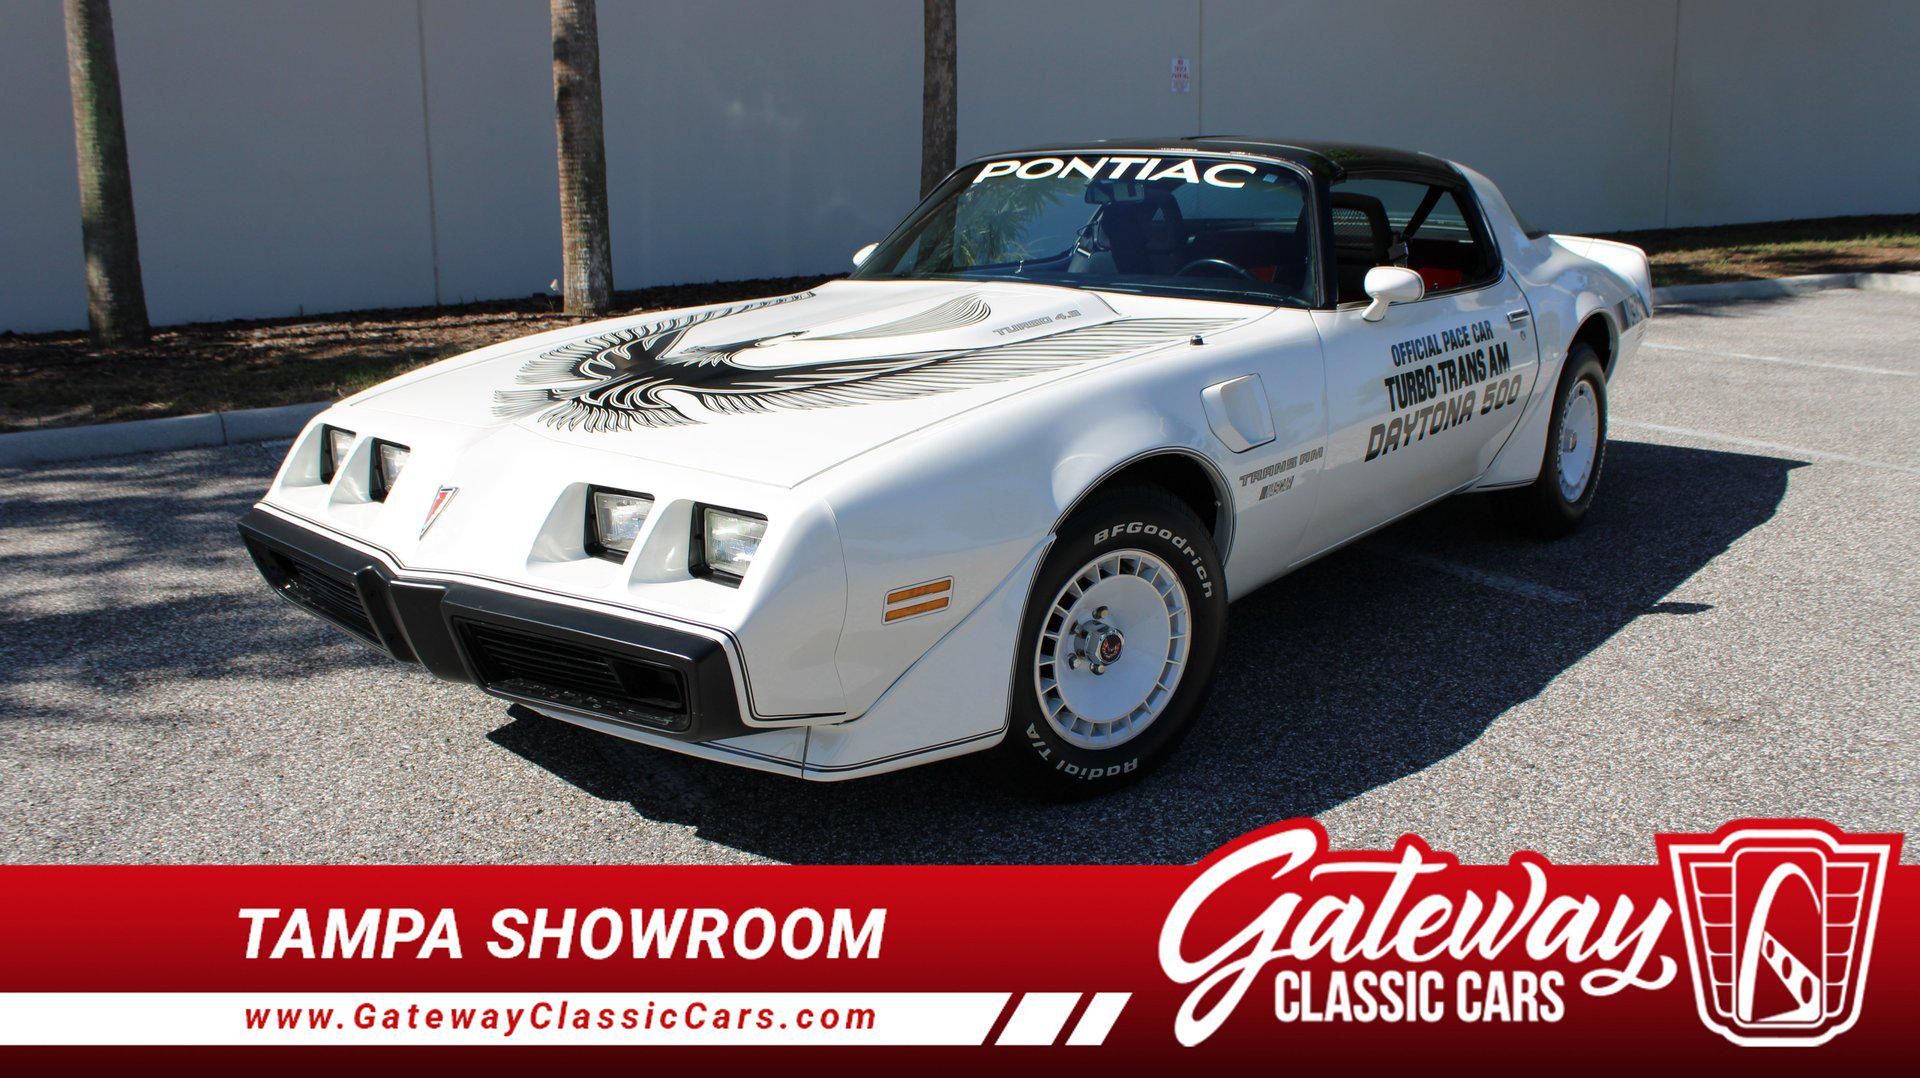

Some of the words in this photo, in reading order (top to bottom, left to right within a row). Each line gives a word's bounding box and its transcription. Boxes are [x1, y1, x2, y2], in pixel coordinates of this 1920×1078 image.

[973, 156, 1257, 188] PONTIAC
[992, 316, 1053, 336] TURBO
[1391, 334, 1442, 367] OFFICIAL
[1441, 325, 1471, 353] PACE
[1471, 319, 1494, 344] CAR
[1384, 349, 1488, 413] TURBO-TRANS
[1488, 341, 1512, 378] AM
[1364, 390, 1477, 463] DAYTONA
[1480, 374, 1523, 416] 500
[1239, 456, 1299, 487] TRANS
[1298, 446, 1324, 466] AM
[1093, 521, 1214, 598] BFGoodrich
[1026, 722, 1053, 761] T/A
[1055, 757, 1140, 781] Radial
